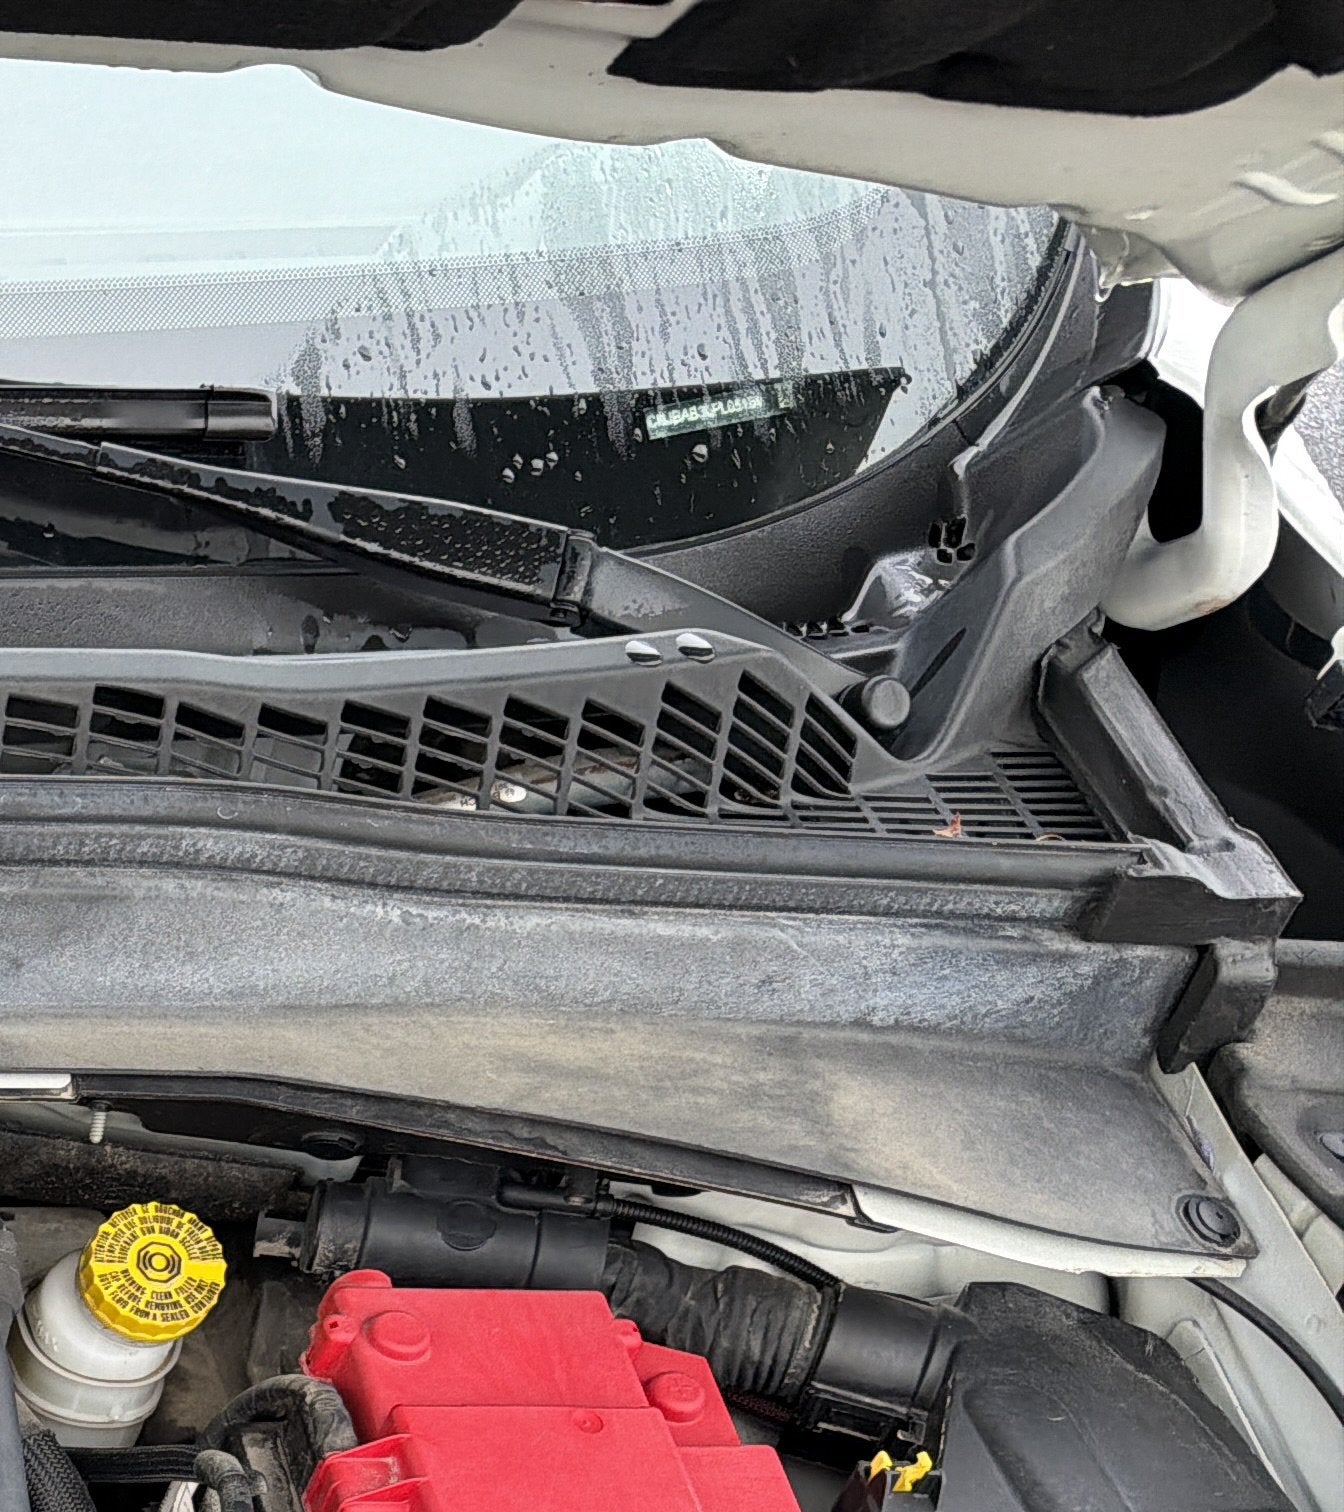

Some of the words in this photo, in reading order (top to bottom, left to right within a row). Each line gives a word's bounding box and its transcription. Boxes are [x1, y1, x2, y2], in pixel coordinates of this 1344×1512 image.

[108, 1291, 130, 1310] FLUID
[129, 1306, 152, 1320] FROM
[152, 1312, 158, 1322] A
[160, 1309, 191, 1322] SEALED
[190, 1282, 221, 1314] CONTAINER
[116, 1283, 143, 1304] BEFORE
[183, 1293, 198, 1306] USE
[151, 1291, 173, 1300] CLEAN
